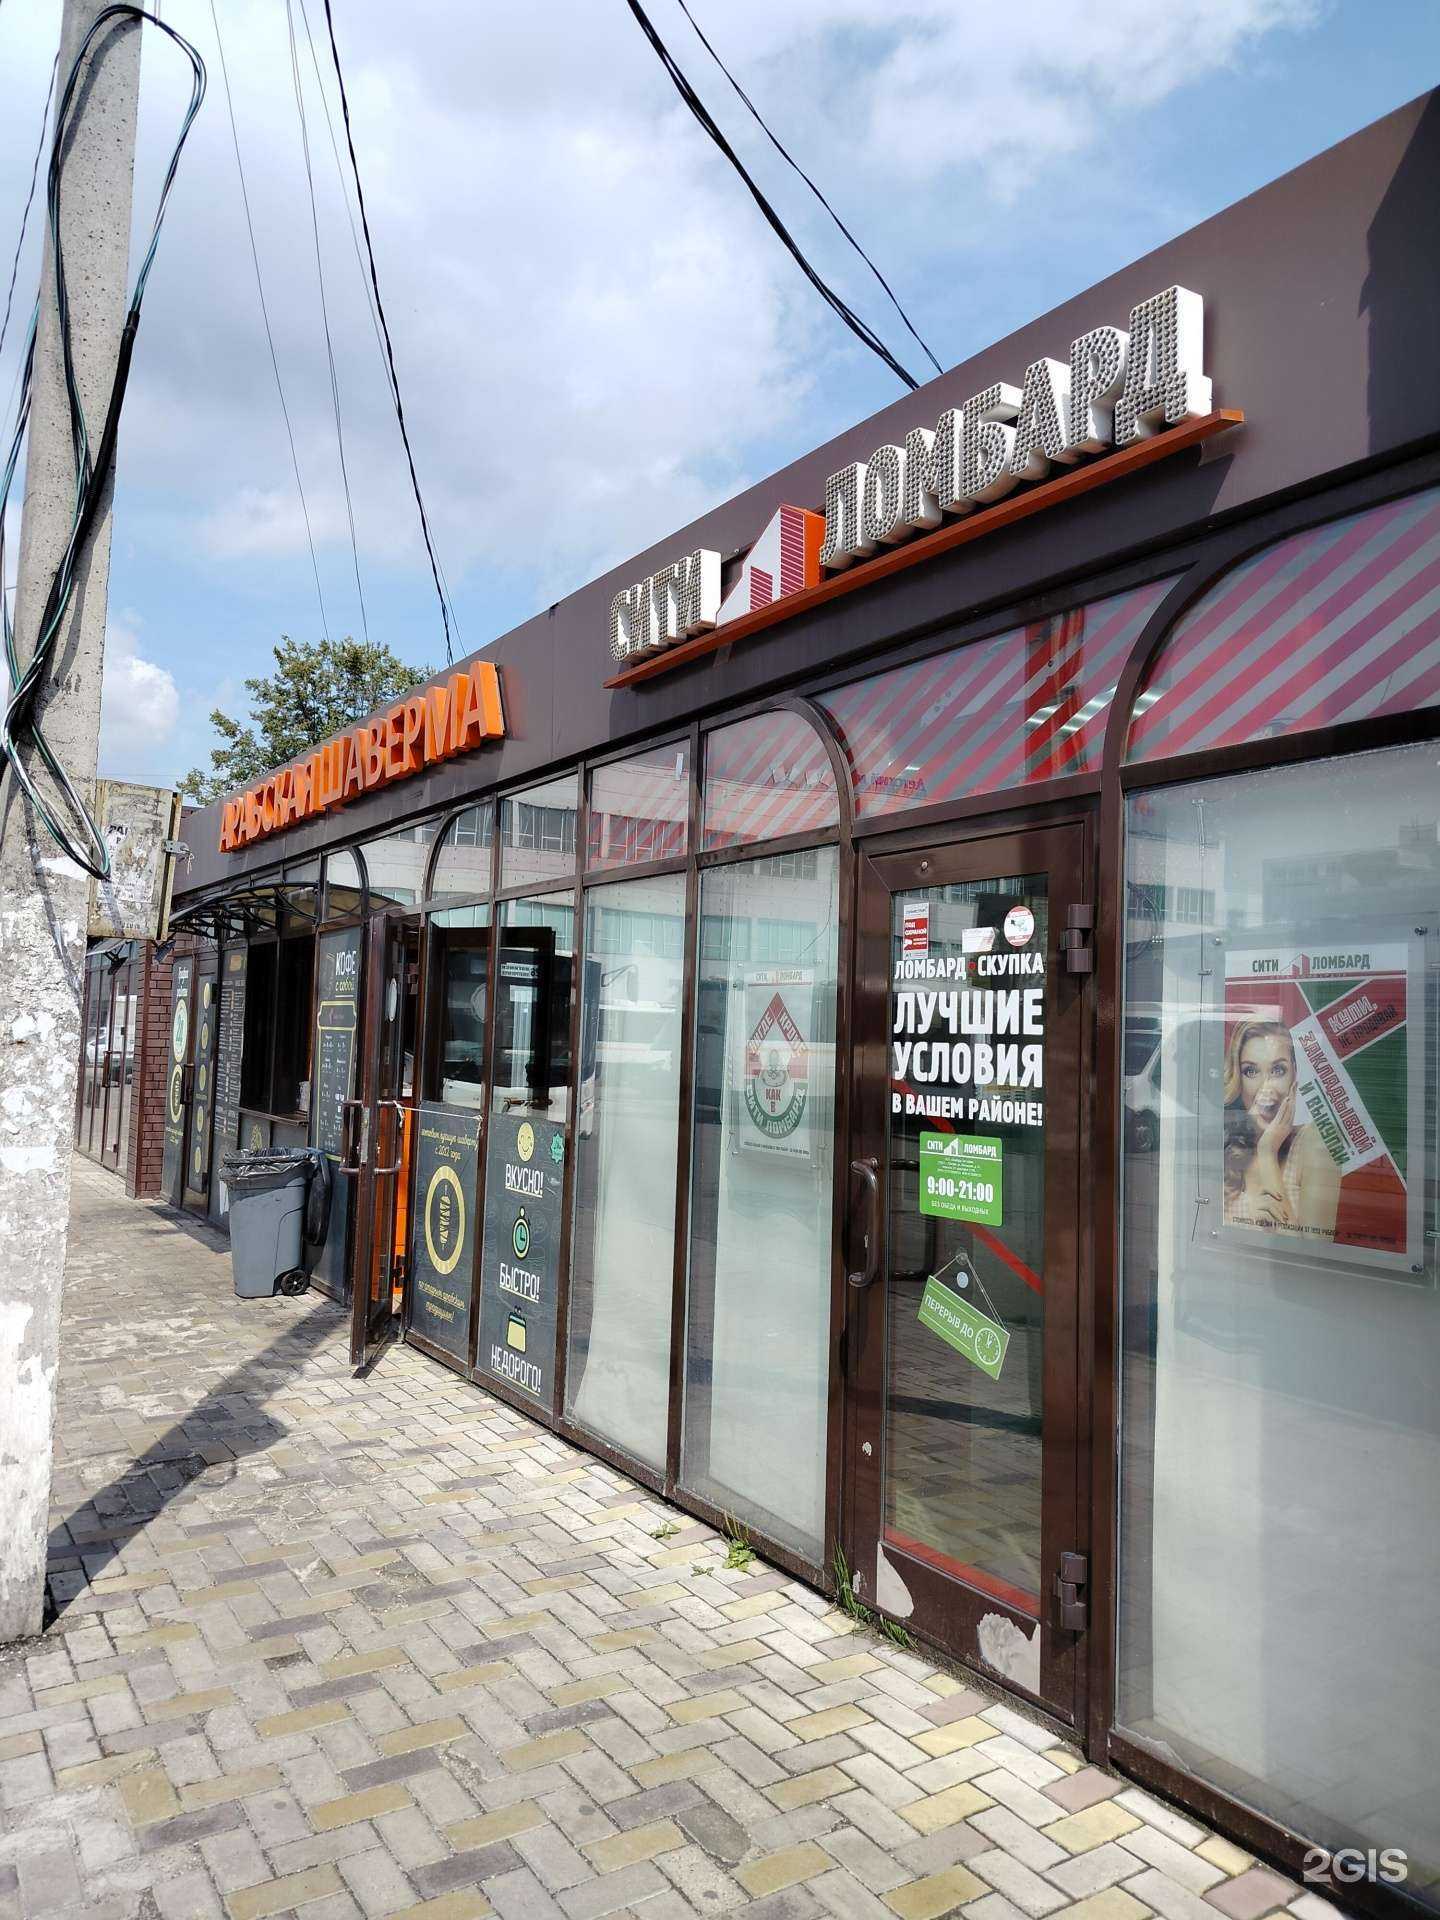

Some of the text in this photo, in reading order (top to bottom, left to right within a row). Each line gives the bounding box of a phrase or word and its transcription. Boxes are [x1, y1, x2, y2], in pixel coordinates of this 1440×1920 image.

[609, 285, 1212, 662] СИТИ ЛОМБАРД
[319, 661, 504, 806] ШАВЕРМА
[335, 950, 357, 976] КОФЕ
[894, 953, 1044, 980] ЛОМБАРД СКУПКА
[1252, 954, 1370, 972] СИТИ ЛОМБАРД
[893, 989, 1043, 1036] ЛУЧШИЕ
[893, 1042, 1043, 1088] УСЛОВИЯ
[765, 1088, 781, 1101] КАК
[892, 1093, 1043, 1126] В ВАШЕМ РАЙОНЕ!
[1299, 1031, 1376, 1154] ЗАКЛАДЫВАЙ
[1299, 1081, 1355, 1166] И ВЫКУПАЙ
[927, 1140, 997, 1158] СИТИ ЛОМБАРД
[505, 1163, 544, 1195] ВКУСНО!
[927, 1175, 994, 1203] 9:00-21:00
[500, 1262, 540, 1300] БЫСТРО!
[924, 1295, 974, 1338] ПЕРЕРЫВ ДО
[491, 1344, 541, 1393] НЕДОРОГО!
